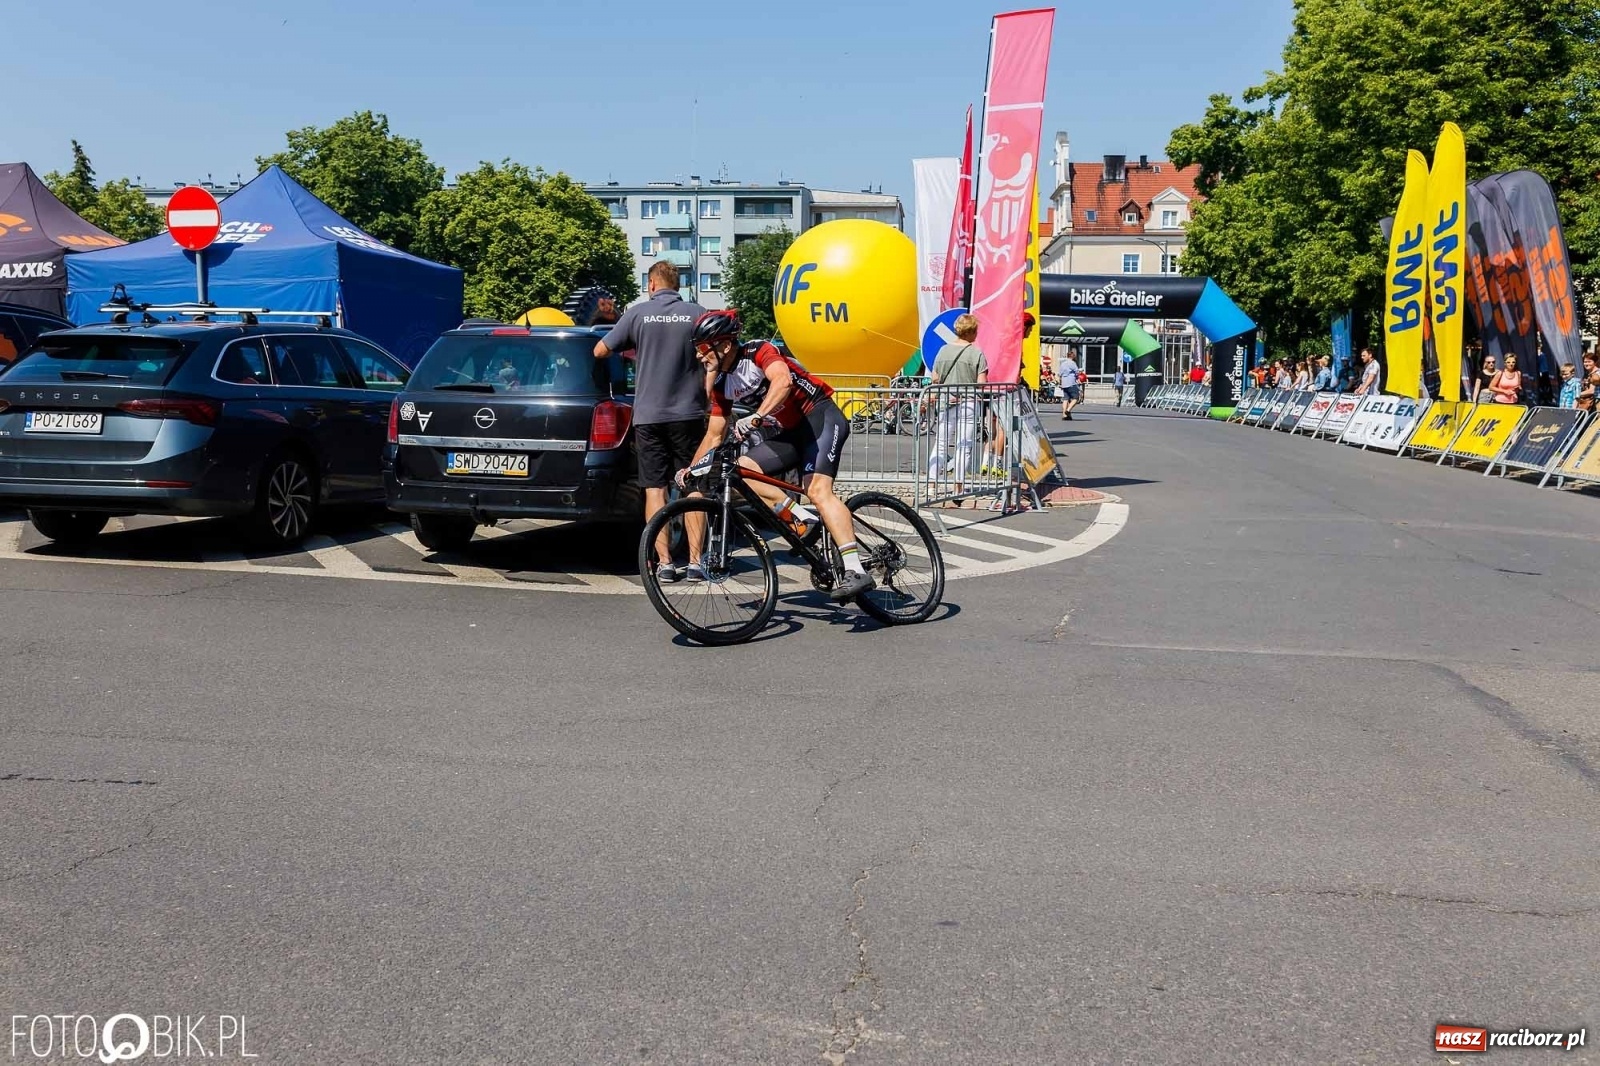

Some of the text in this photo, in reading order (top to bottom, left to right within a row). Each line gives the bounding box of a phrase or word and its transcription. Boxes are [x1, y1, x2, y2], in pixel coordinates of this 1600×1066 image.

[1070, 288, 1163, 307] bike atelier
[643, 313, 692, 324] RACIBÓRZ
[810, 302, 849, 323] FM
[1230, 344, 1244, 401] bike atelier
[34, 413, 98, 429] PO 2TG69
[455, 453, 527, 471] SWD 90476
